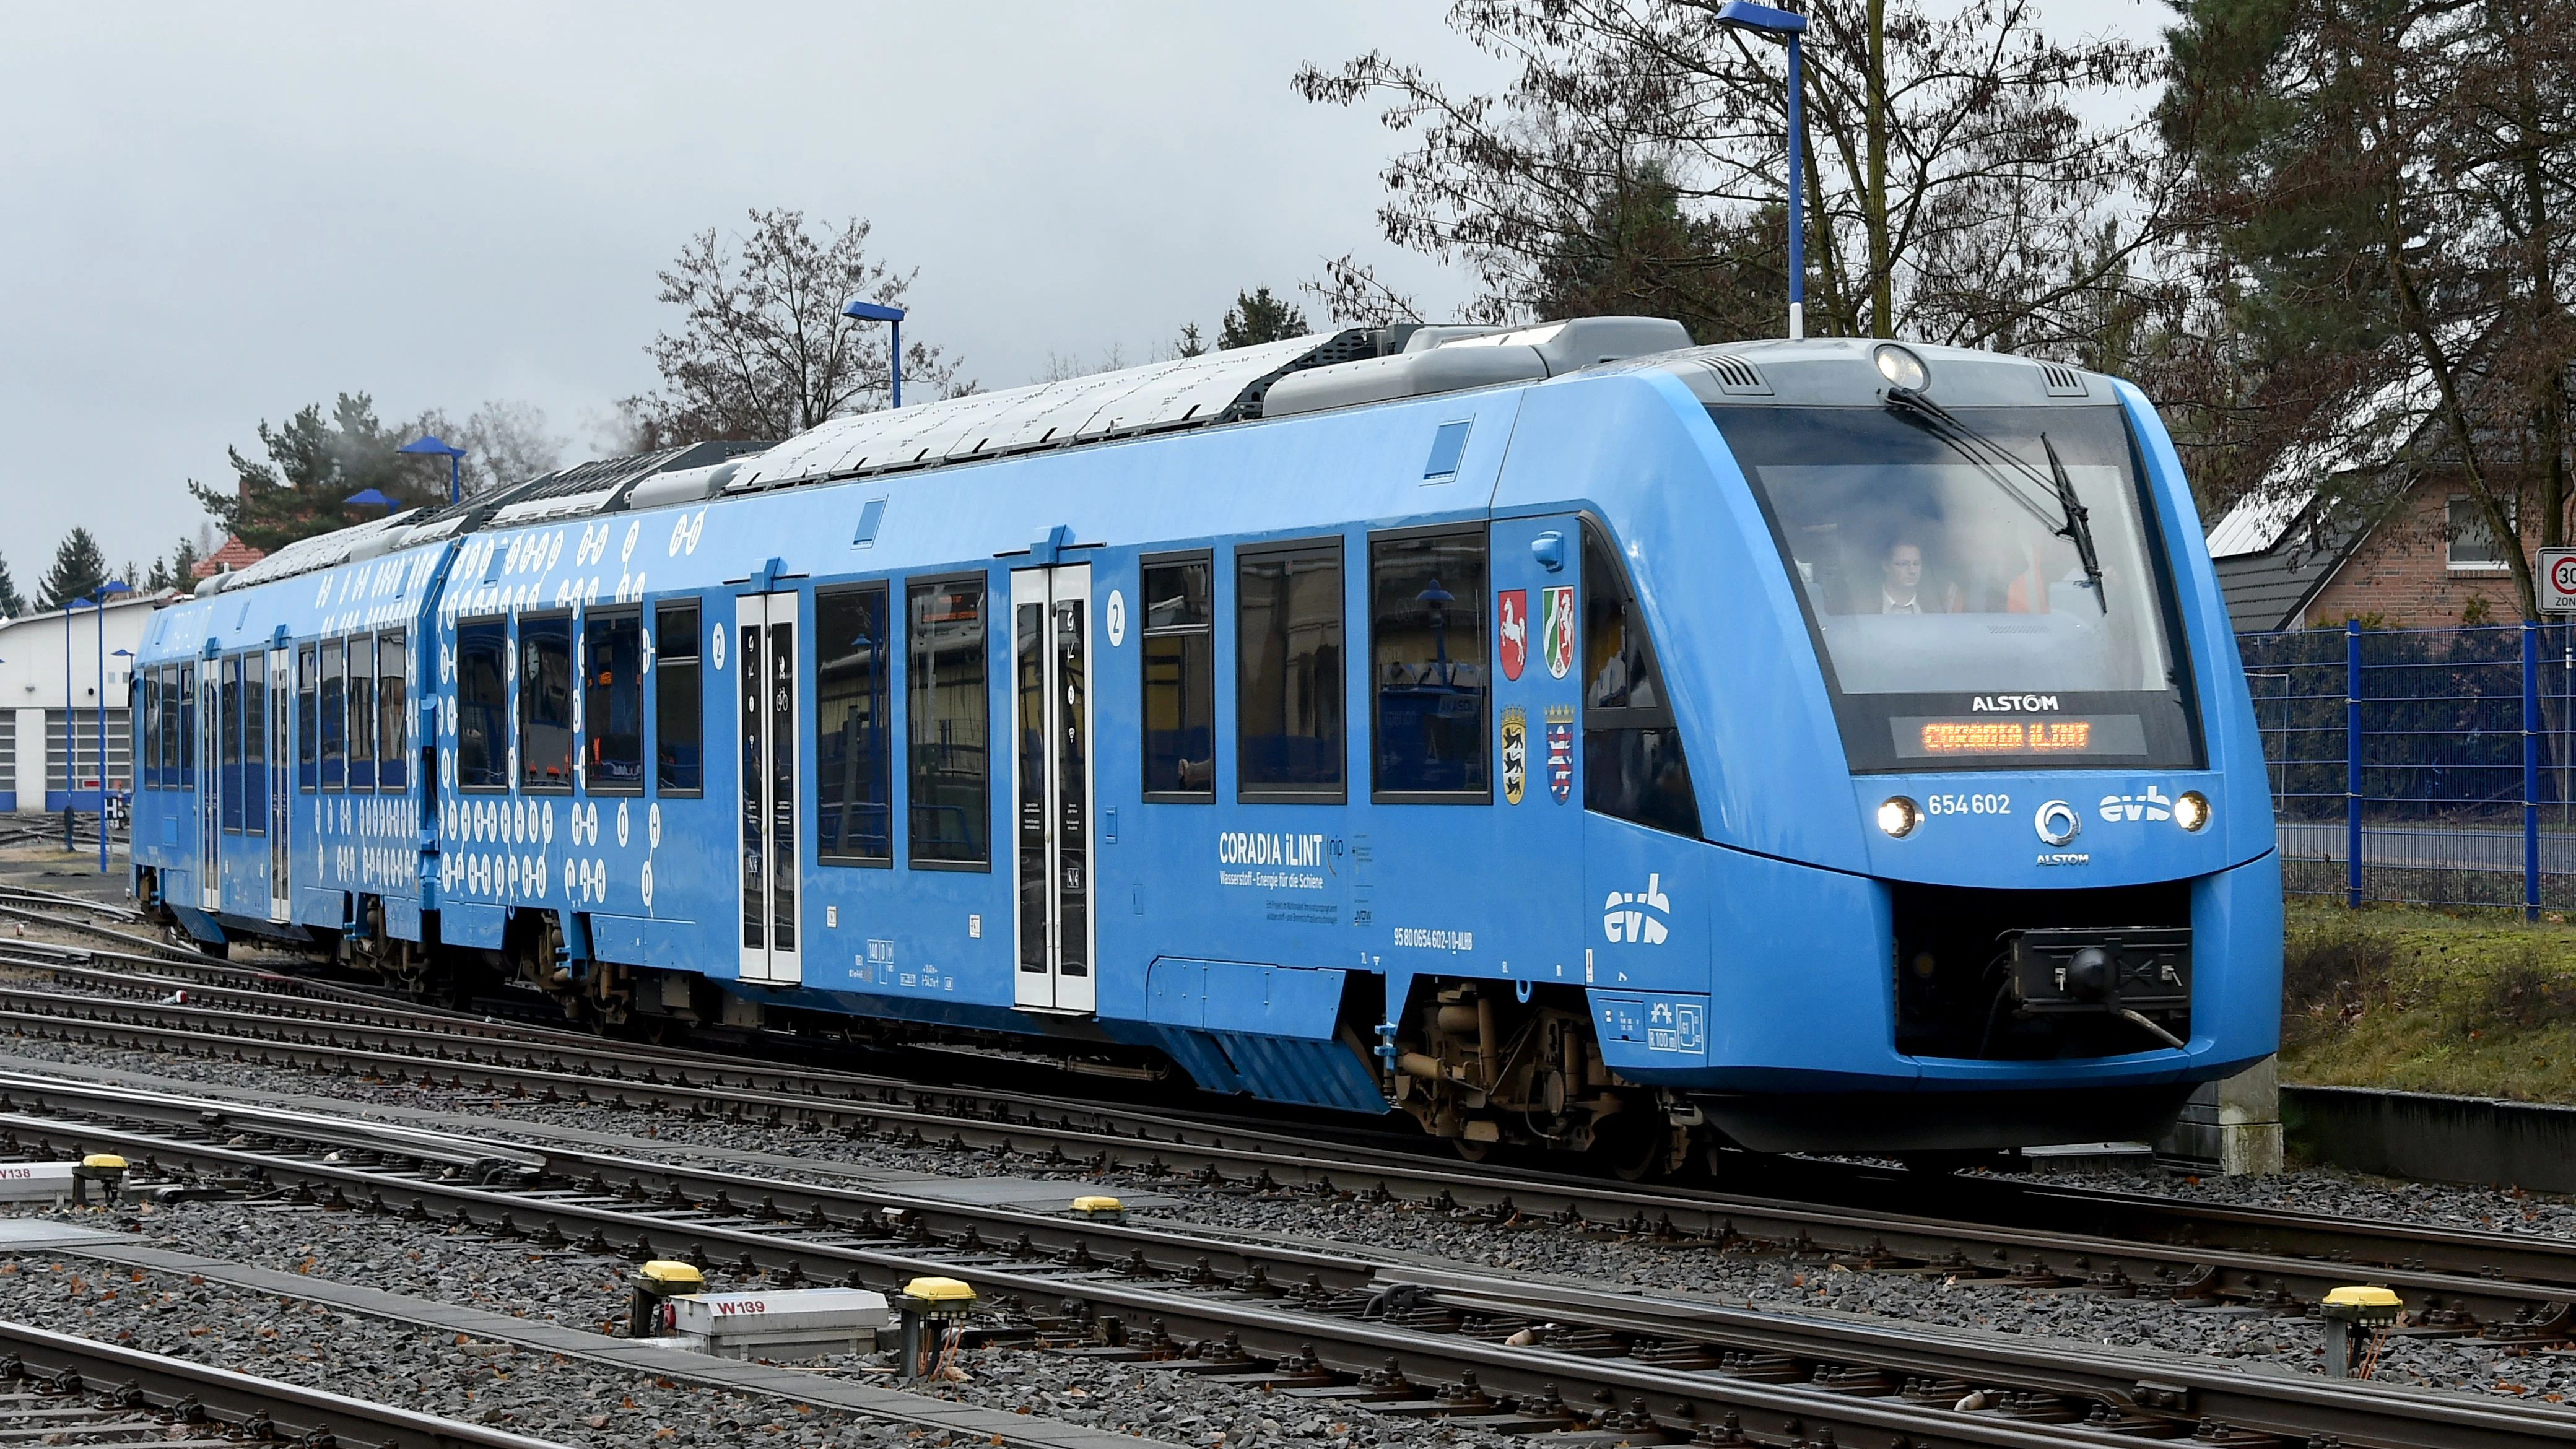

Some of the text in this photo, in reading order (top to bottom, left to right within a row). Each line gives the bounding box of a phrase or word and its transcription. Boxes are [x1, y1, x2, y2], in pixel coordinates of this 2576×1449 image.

[2559, 568, 2576, 584] 30
[1972, 694, 2059, 712] ALSTOM
[1923, 723, 2022, 747] CORADIA
[1928, 794, 2011, 814] 654 602
[2099, 785, 2171, 822] evb
[1219, 832, 1281, 865] CORADIA
[1286, 833, 1323, 866] iLINT
[2037, 854, 2089, 866] ALSTOM
[1279, 872, 1288, 887] für
[1289, 873, 1298, 888] die
[1299, 873, 1323, 889] Schiene
[1604, 873, 1670, 945] evb
[1394, 928, 1403, 946] 95
[1404, 928, 1413, 947] 80
[1414, 929, 1431, 947] 0654
[1432, 930, 1451, 949] 602-1
[1656, 1033, 1668, 1048] 100
[716, 1301, 765, 1315] W139
